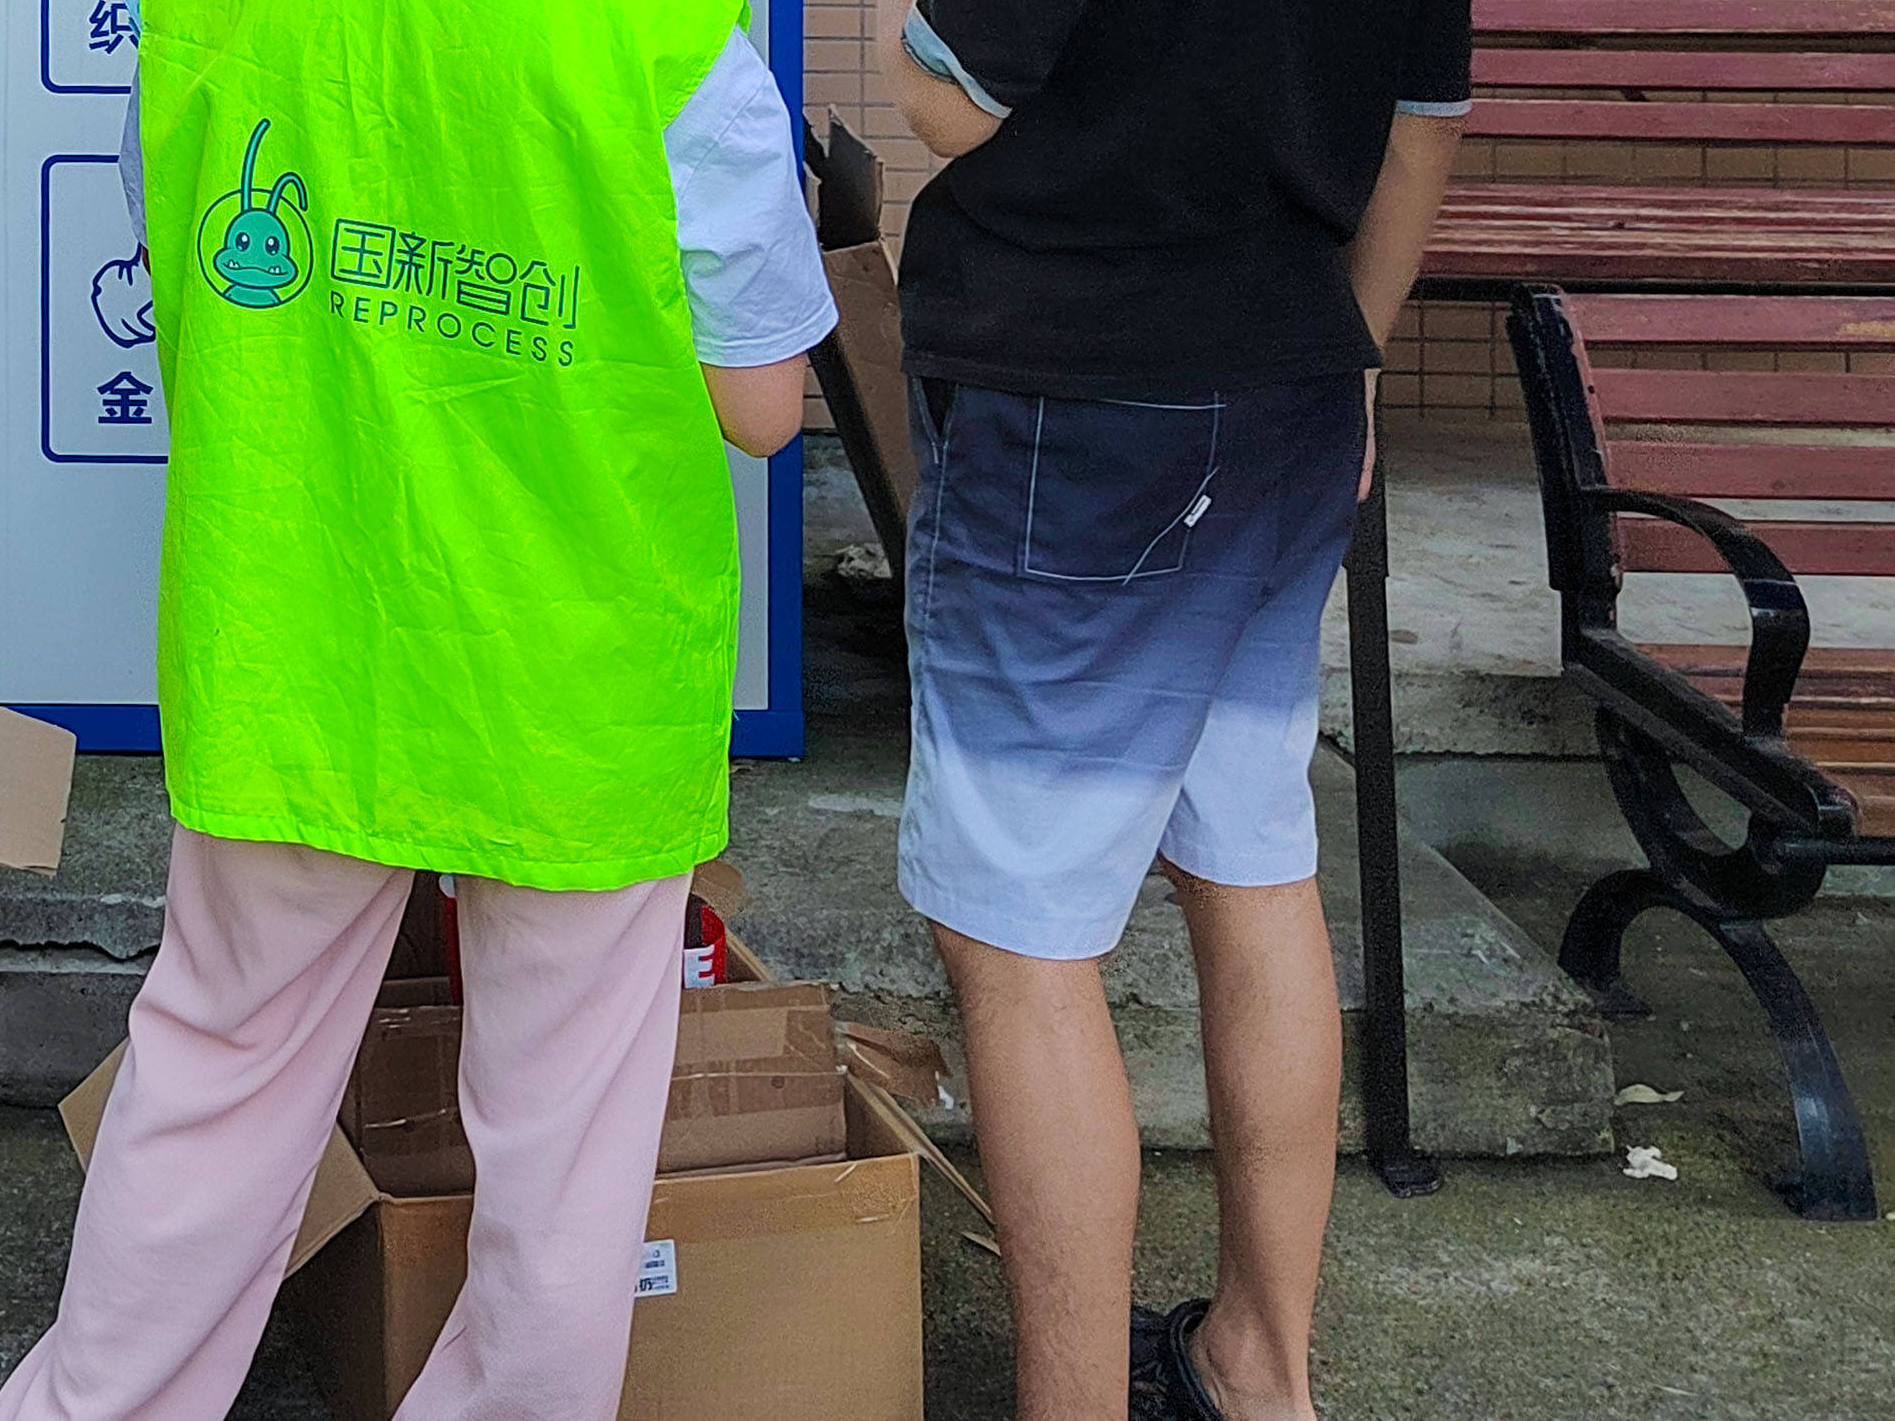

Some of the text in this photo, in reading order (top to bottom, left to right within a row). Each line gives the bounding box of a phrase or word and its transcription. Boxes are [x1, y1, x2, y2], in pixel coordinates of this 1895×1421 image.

[331, 218, 580, 330] 国新智创
[330, 290, 574, 367] REPROCESS
[97, 371, 153, 424] 金
